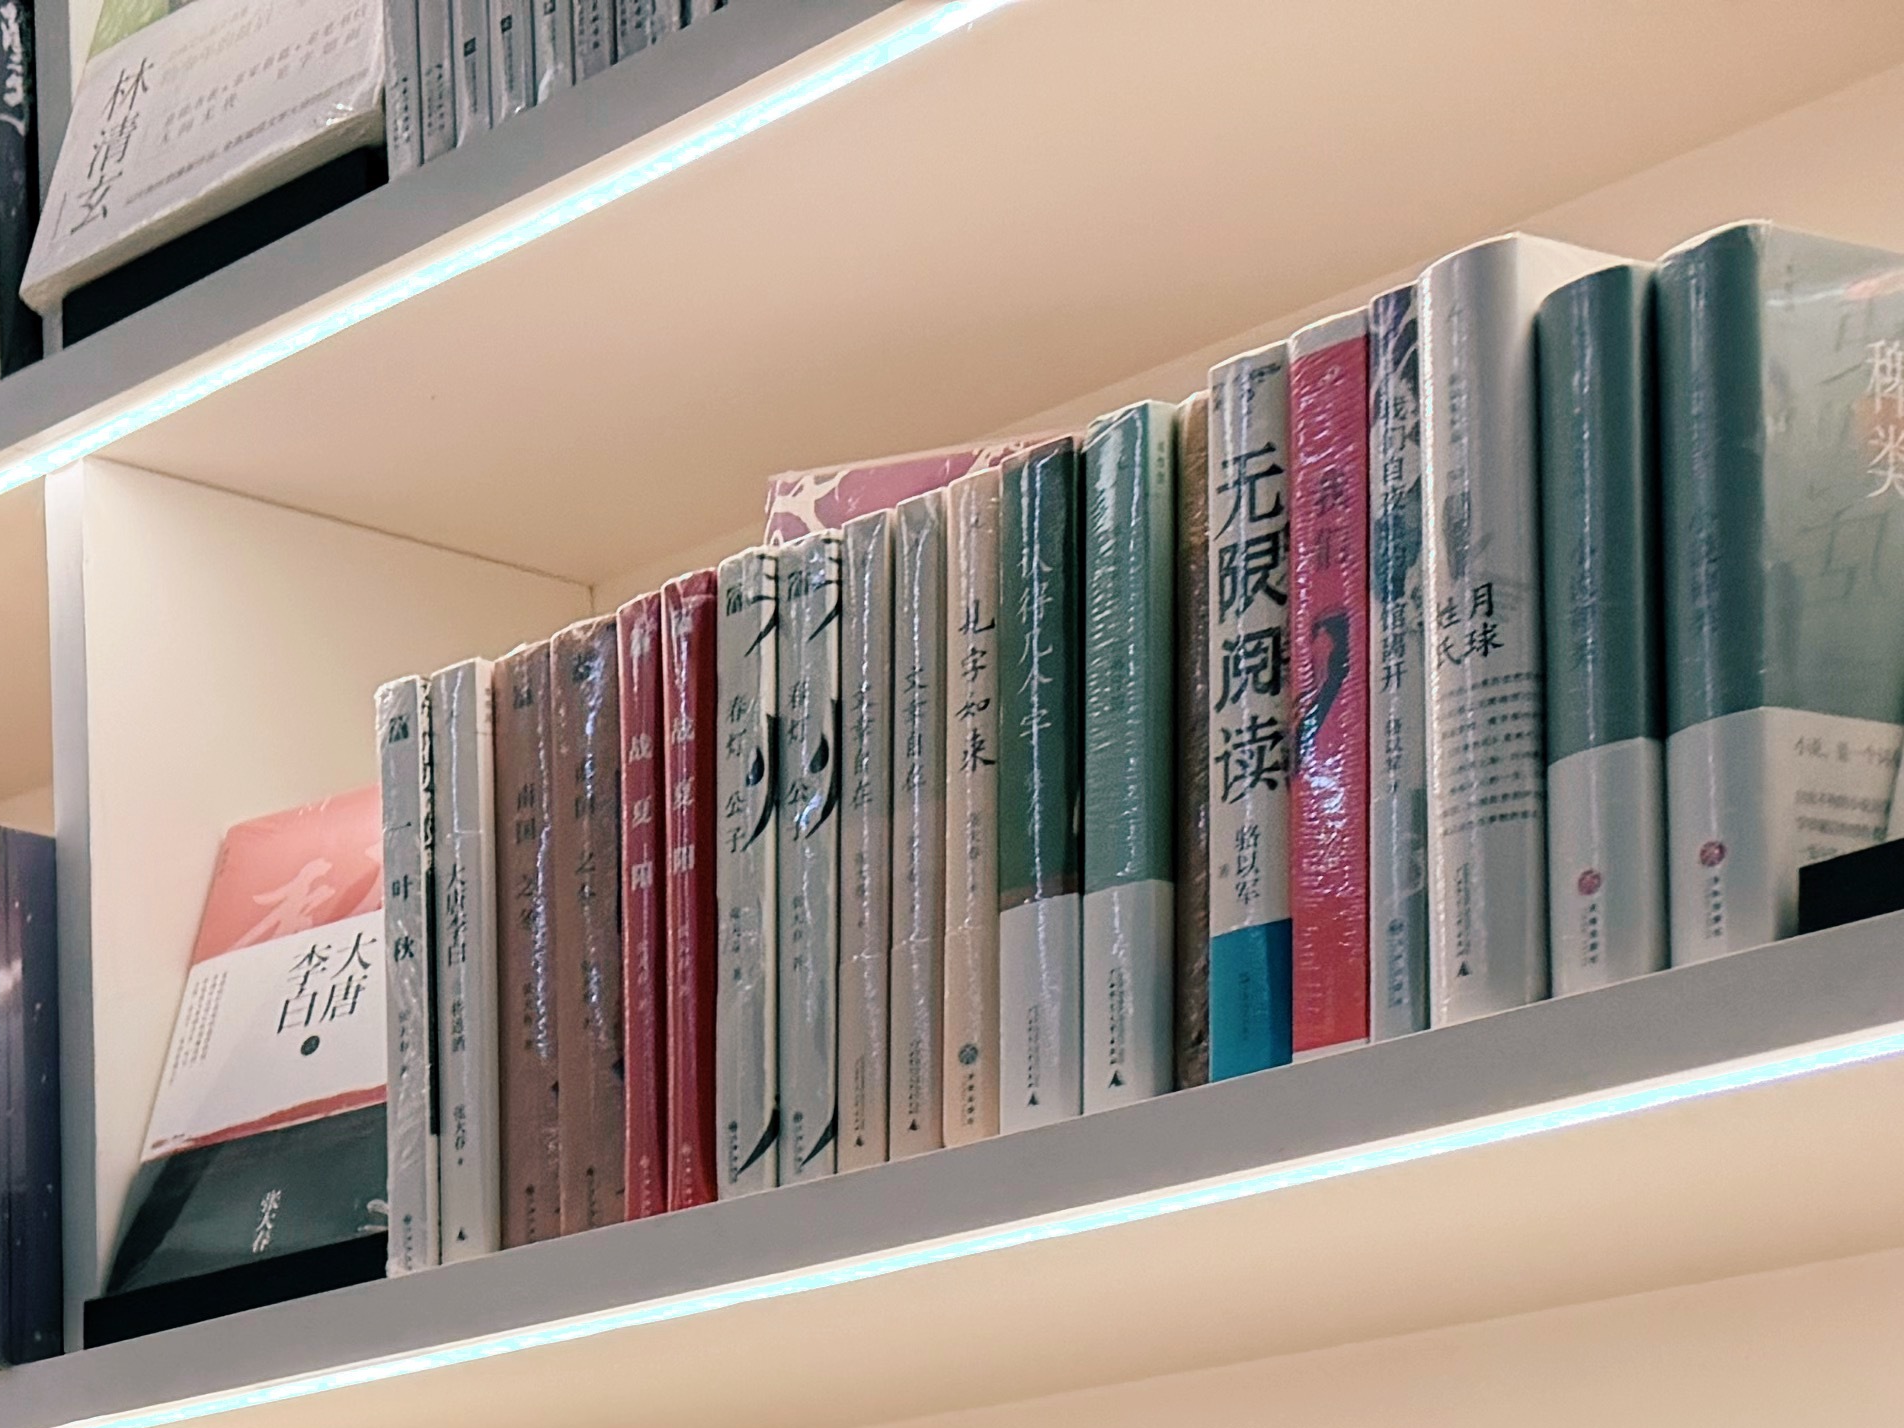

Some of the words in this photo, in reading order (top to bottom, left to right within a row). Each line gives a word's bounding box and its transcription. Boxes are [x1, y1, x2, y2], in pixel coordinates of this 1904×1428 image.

[50, 56, 154, 236] 林清玄
[1212, 442, 1289, 805] 无限阅读
[1435, 598, 1463, 669] 姓氏
[1465, 582, 1503, 658] 月球
[627, 732, 656, 890] 战夏阳
[724, 697, 750, 854] 春灯公子
[386, 820, 417, 964] 一叶秋
[445, 863, 468, 966] 大唐李白
[1235, 825, 1261, 906] 骆以军
[276, 944, 330, 1036] 李白
[320, 931, 378, 1021] 大唐
